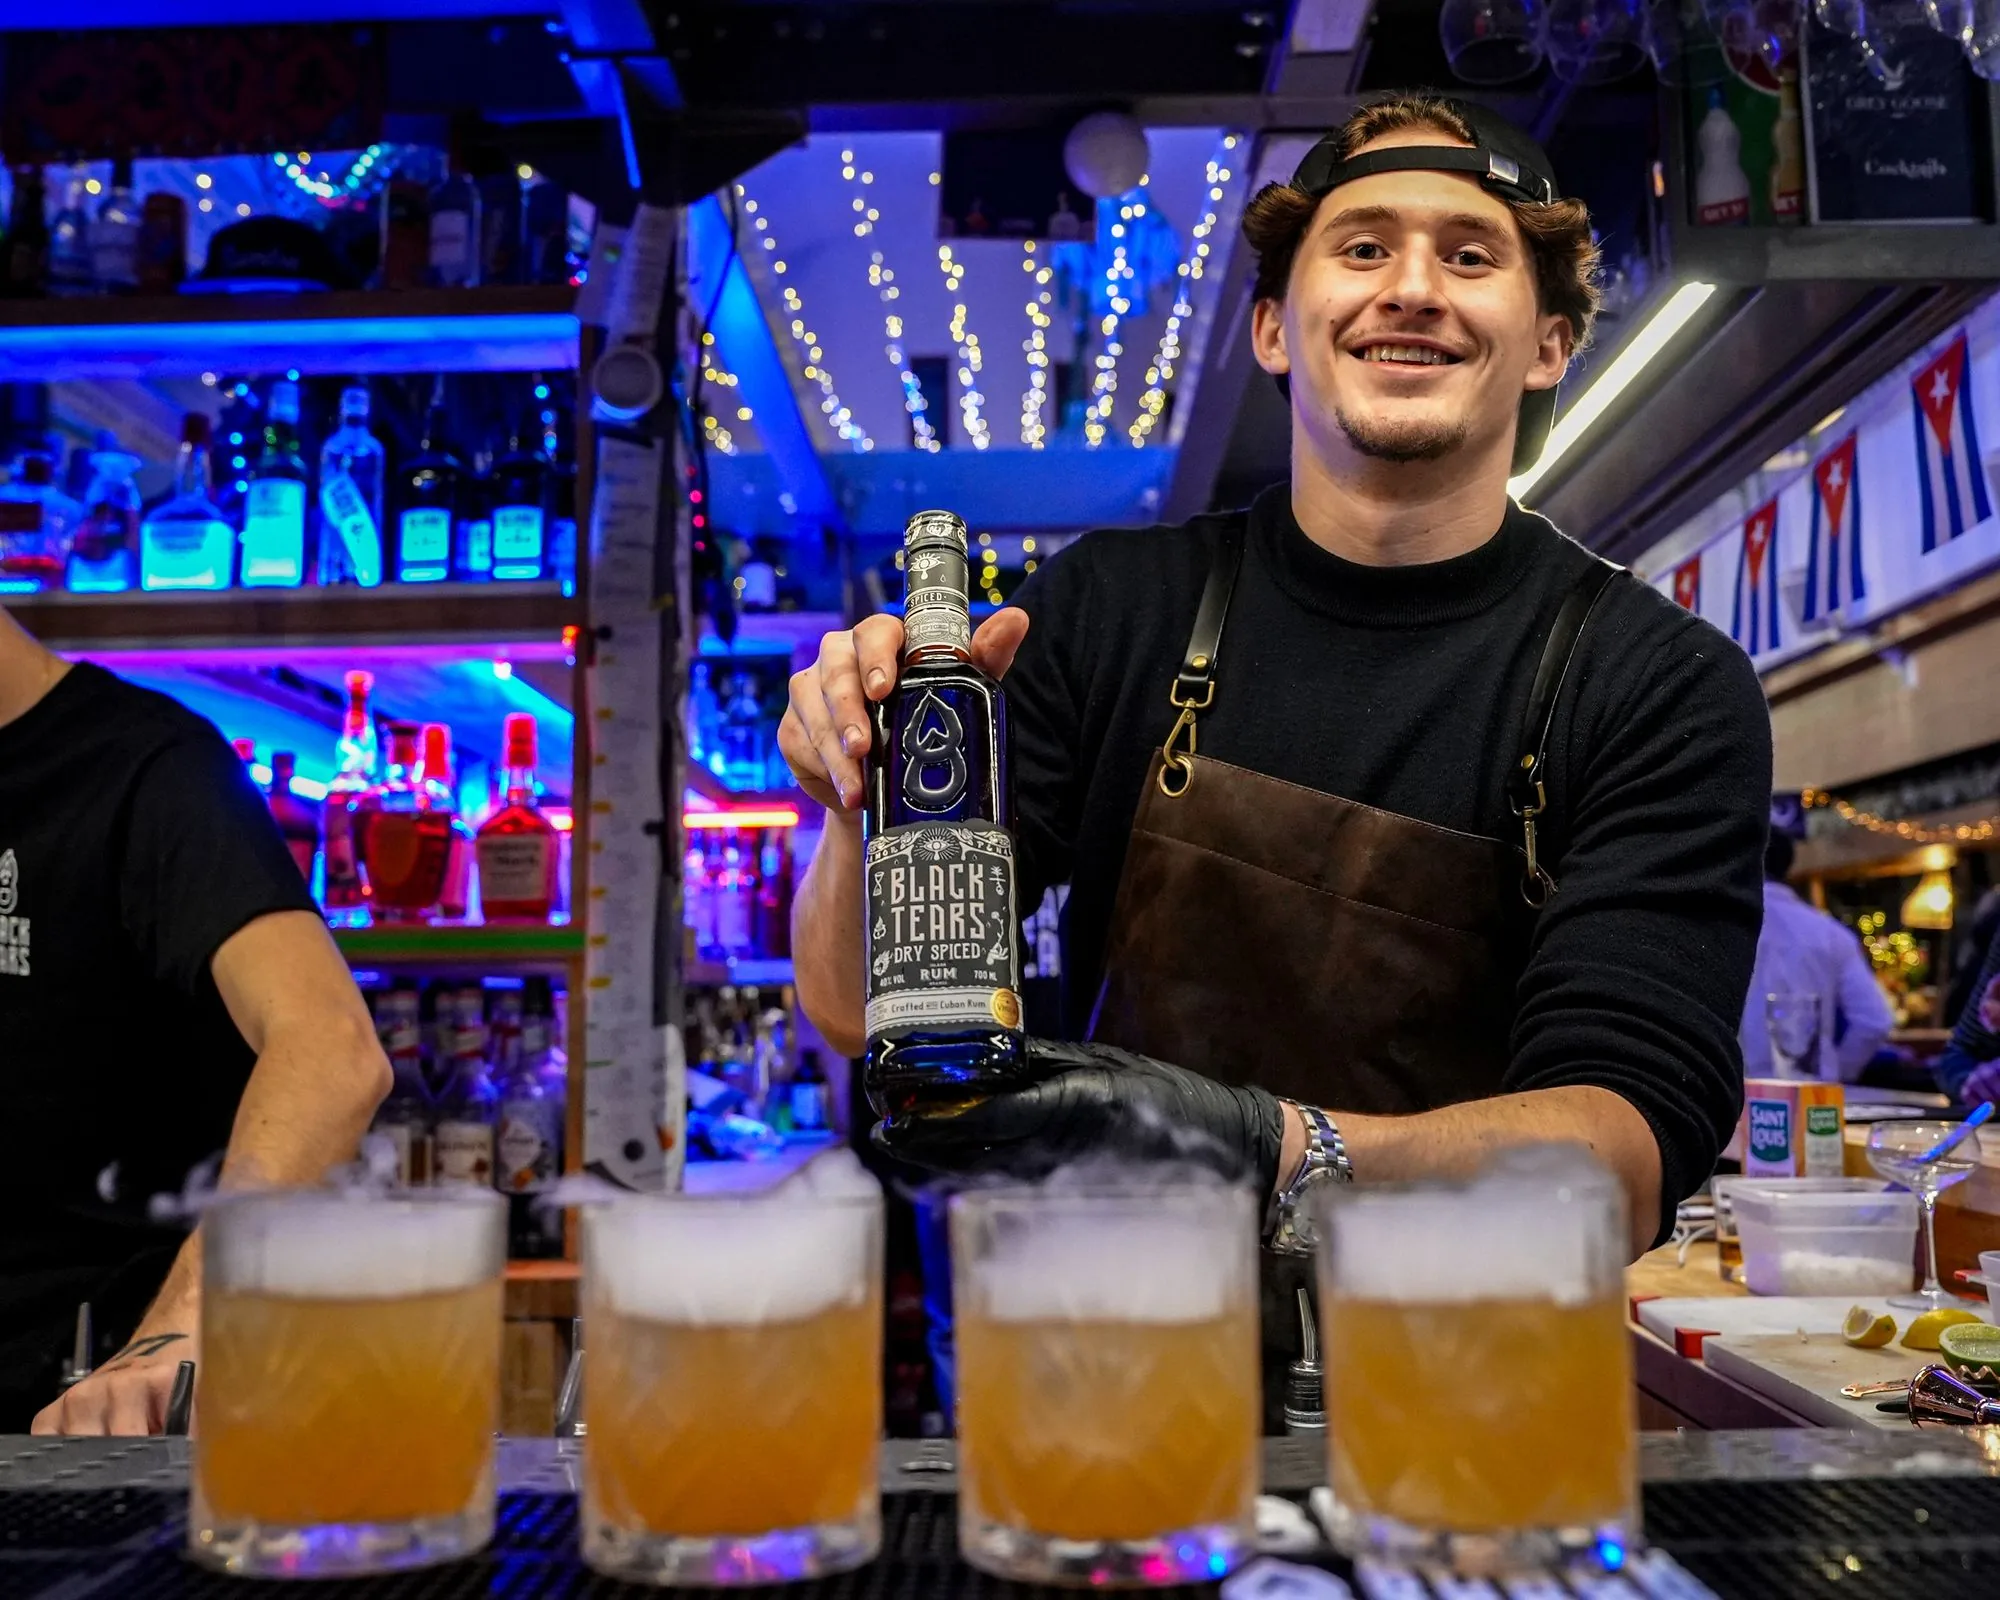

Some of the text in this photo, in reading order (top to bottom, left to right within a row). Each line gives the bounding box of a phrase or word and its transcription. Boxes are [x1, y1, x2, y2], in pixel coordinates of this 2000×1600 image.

[910, 592, 943, 607] SPICED
[890, 863, 985, 905] BLACK
[890, 902, 986, 944] TEARS
[894, 943, 981, 964] DRY SPICED
[893, 974, 906, 984] VOL
[920, 967, 958, 981] RUM
[974, 969, 988, 980] 700
[891, 1001, 924, 1013] Crafted
[940, 998, 965, 1009] Cuban
[967, 998, 986, 1008] Rum
[1752, 1104, 1786, 1127] SAINT
[1752, 1127, 1786, 1150] LOUIS
